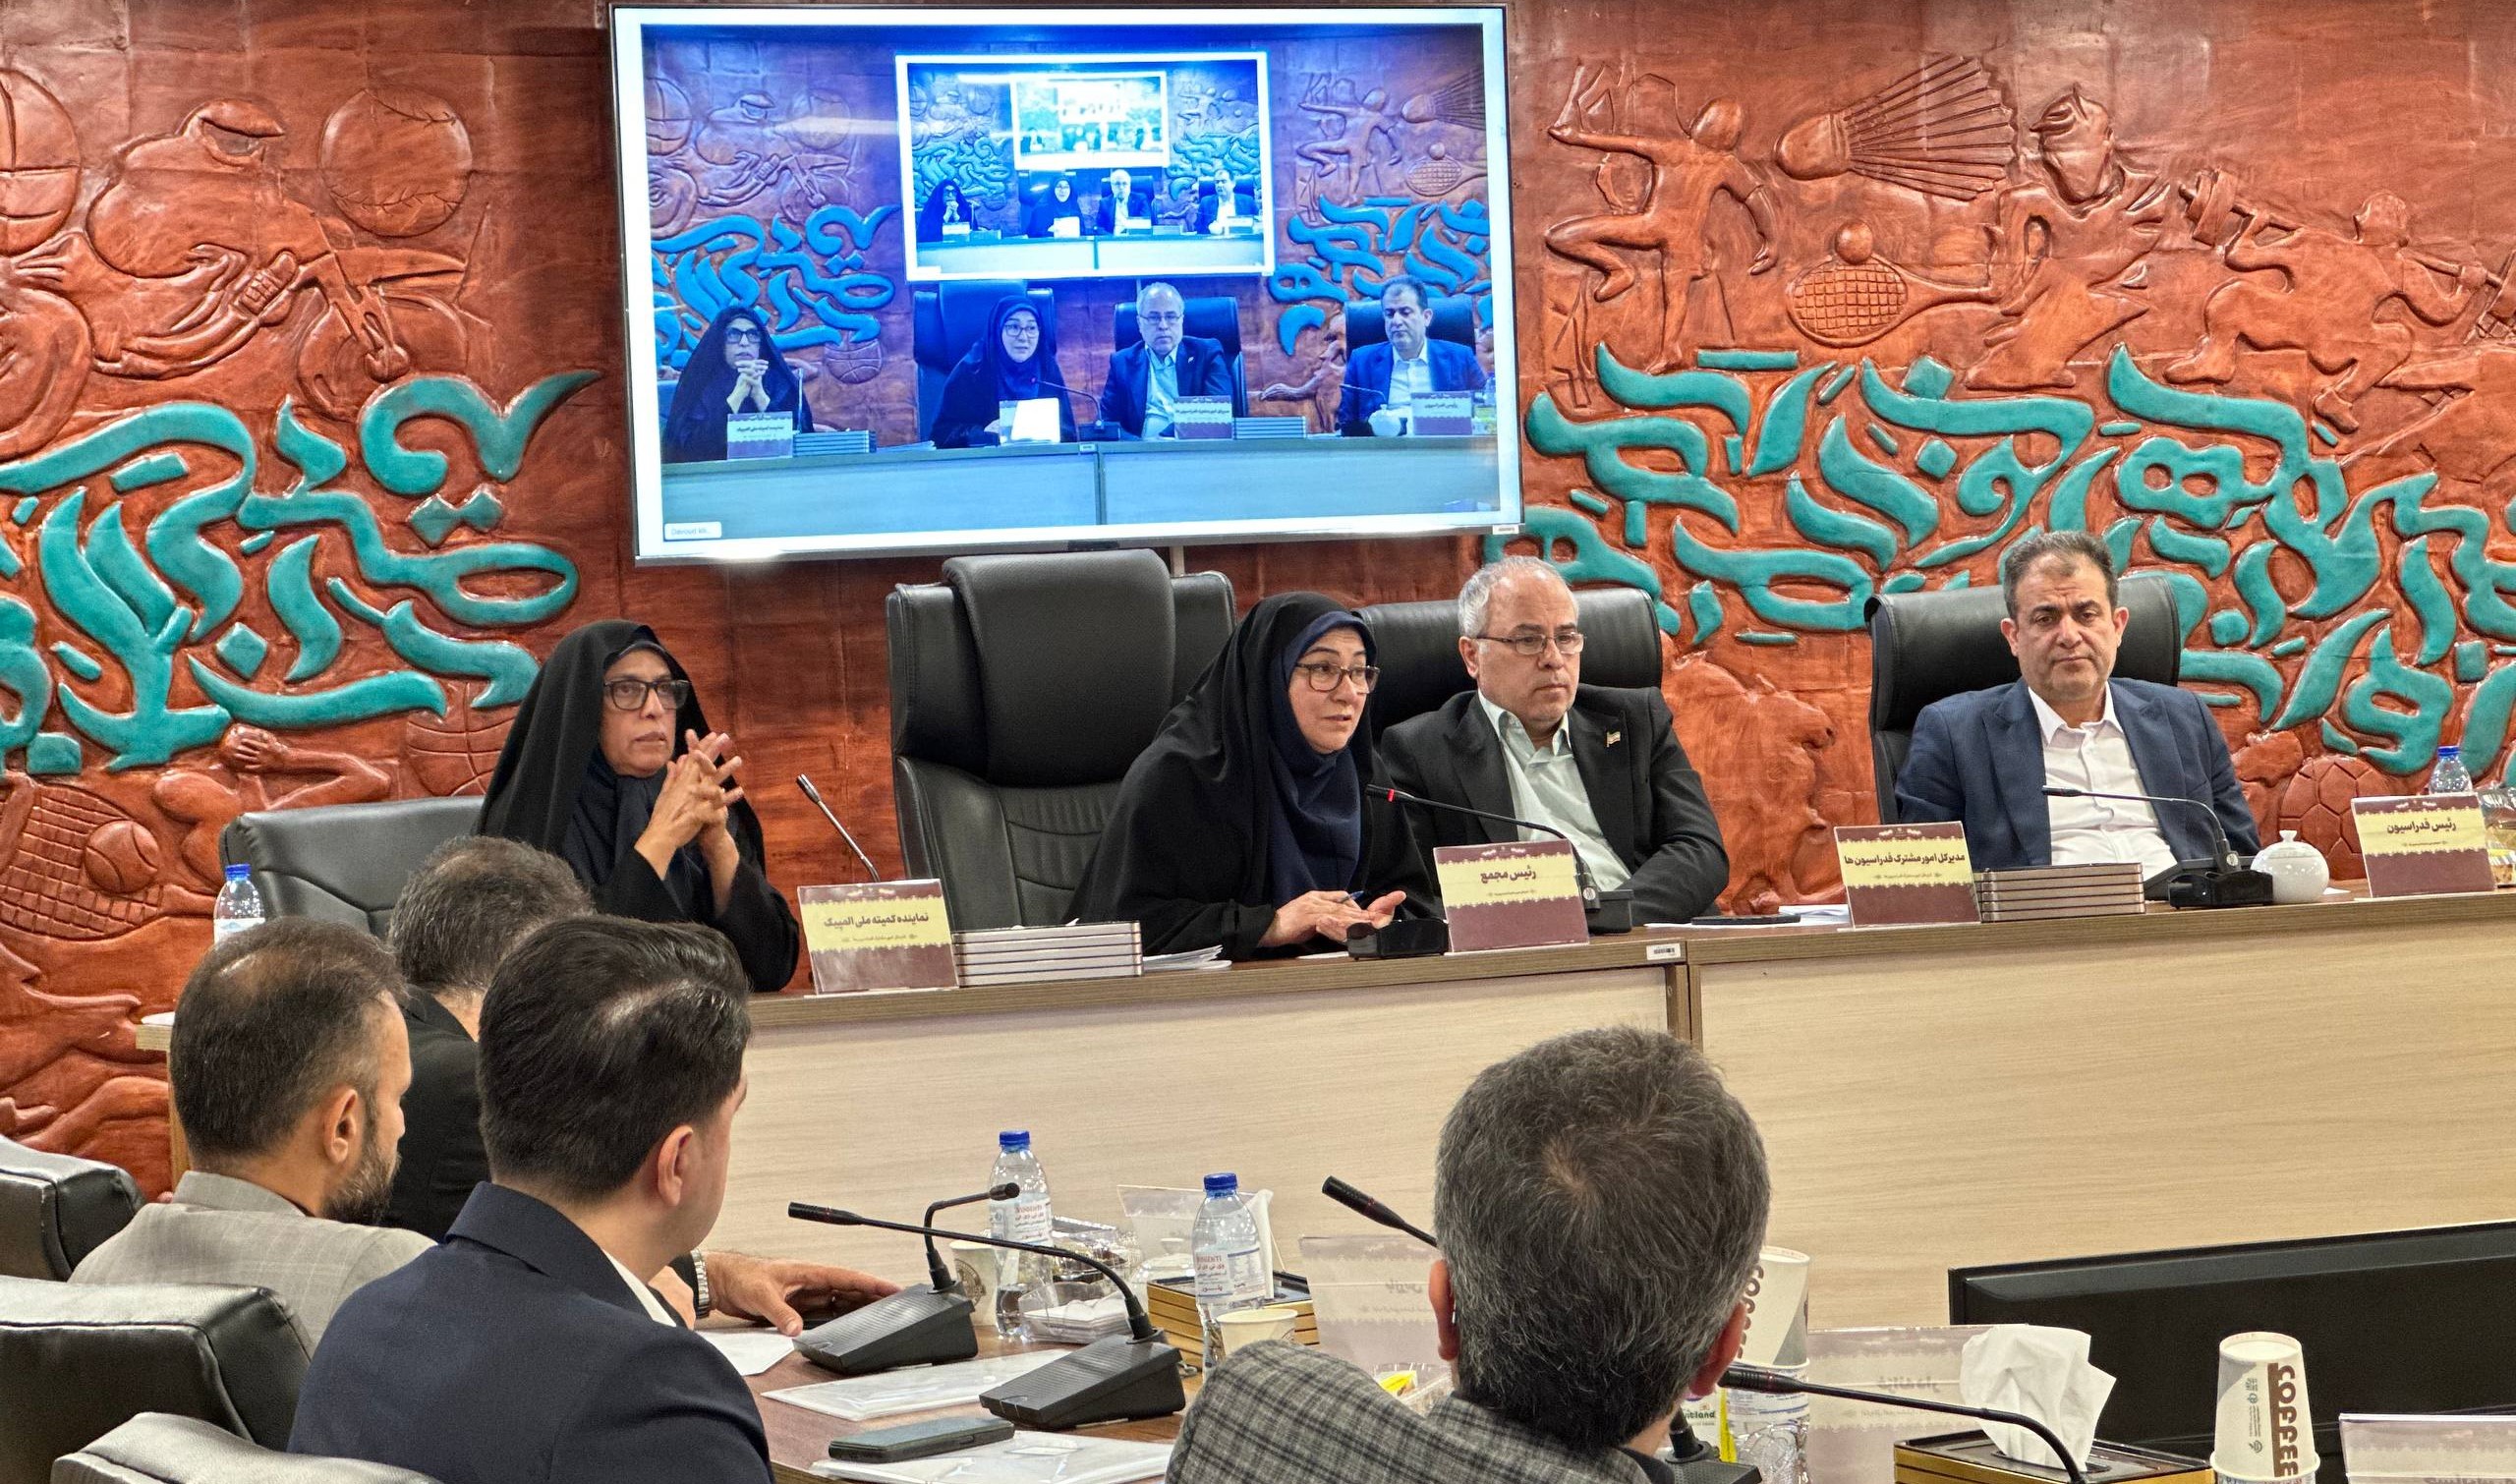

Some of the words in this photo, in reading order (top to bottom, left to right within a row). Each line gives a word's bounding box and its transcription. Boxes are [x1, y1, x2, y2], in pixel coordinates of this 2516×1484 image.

[2387, 818, 2430, 833] فدراسیون
[2431, 817, 2457, 831] رئیس
[1844, 855, 1854, 864] ها
[1854, 851, 1893, 866] فدراسیون
[1894, 852, 1921, 865] مشترک
[1921, 852, 1937, 865] امور
[1480, 871, 1509, 884] مجمع
[1510, 865, 1537, 881] رئیس
[824, 916, 854, 931] المپیک
[855, 915, 871, 928] ملی
[872, 914, 896, 927] کمیته
[897, 912, 929, 925] نماینده
[2273, 1364, 2299, 1477] COFFEE
